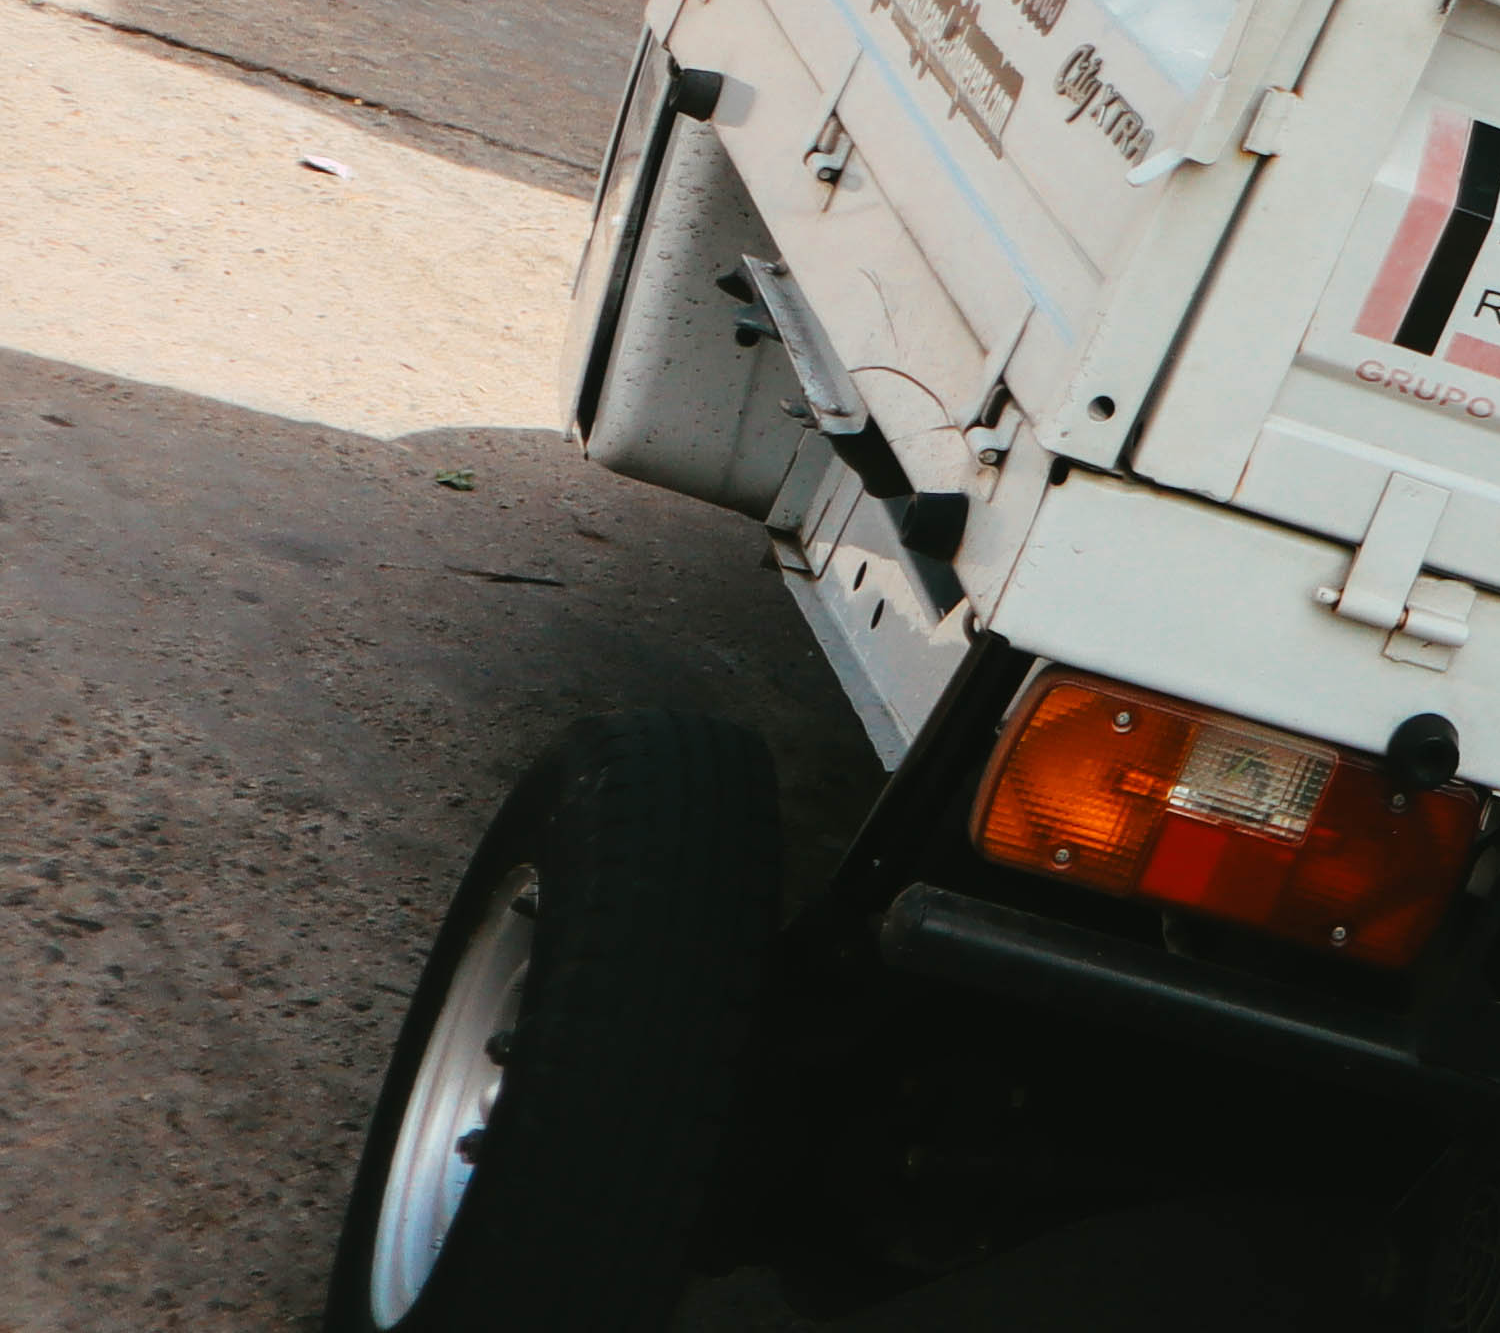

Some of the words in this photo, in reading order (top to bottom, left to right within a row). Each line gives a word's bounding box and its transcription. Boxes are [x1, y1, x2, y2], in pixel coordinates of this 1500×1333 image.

[1054, 44, 1103, 123] City
[1090, 83, 1154, 167] XTRA
[1355, 359, 1496, 419] GRUPO
